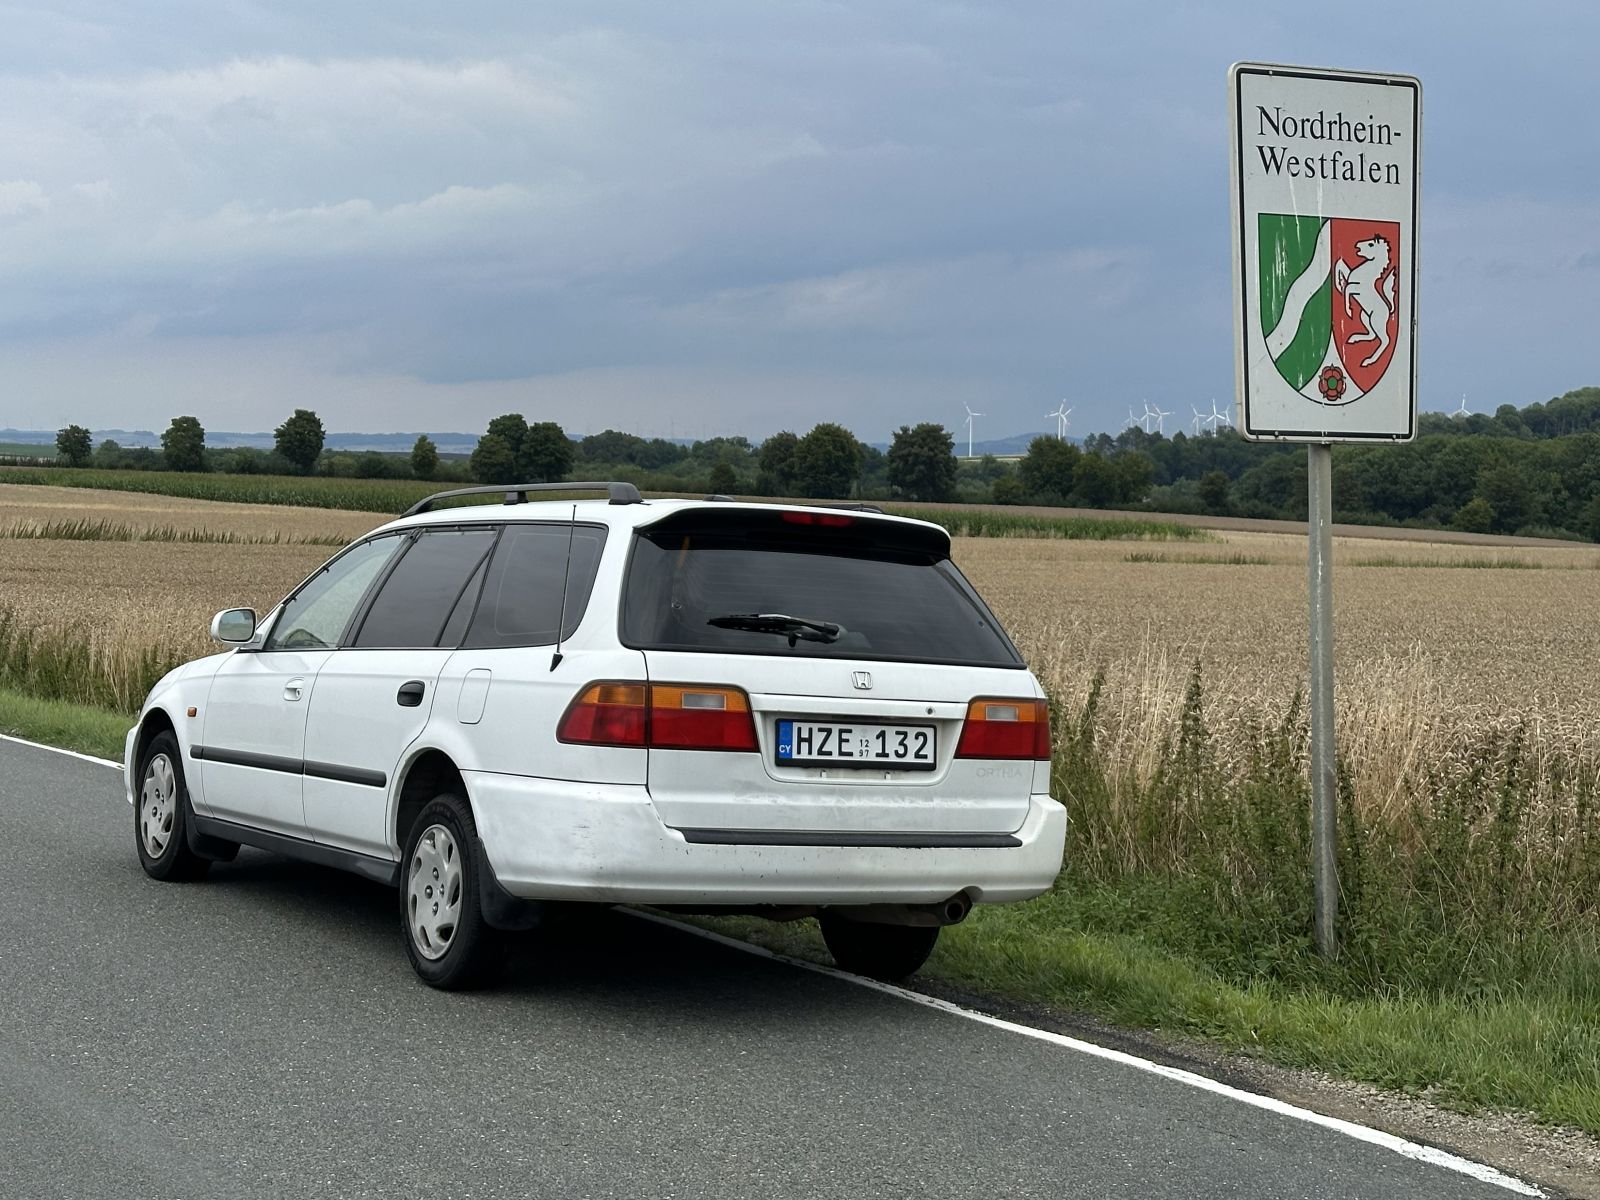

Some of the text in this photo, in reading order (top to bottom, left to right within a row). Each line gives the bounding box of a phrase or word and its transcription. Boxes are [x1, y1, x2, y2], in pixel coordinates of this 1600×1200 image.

[1256, 105, 1401, 145] Nordrhein-
[1256, 145, 1401, 185] Westfalen
[779, 744, 791, 753] CY
[796, 726, 928, 759] HZE 132
[859, 739, 870, 748] 12
[859, 749, 870, 758] 97
